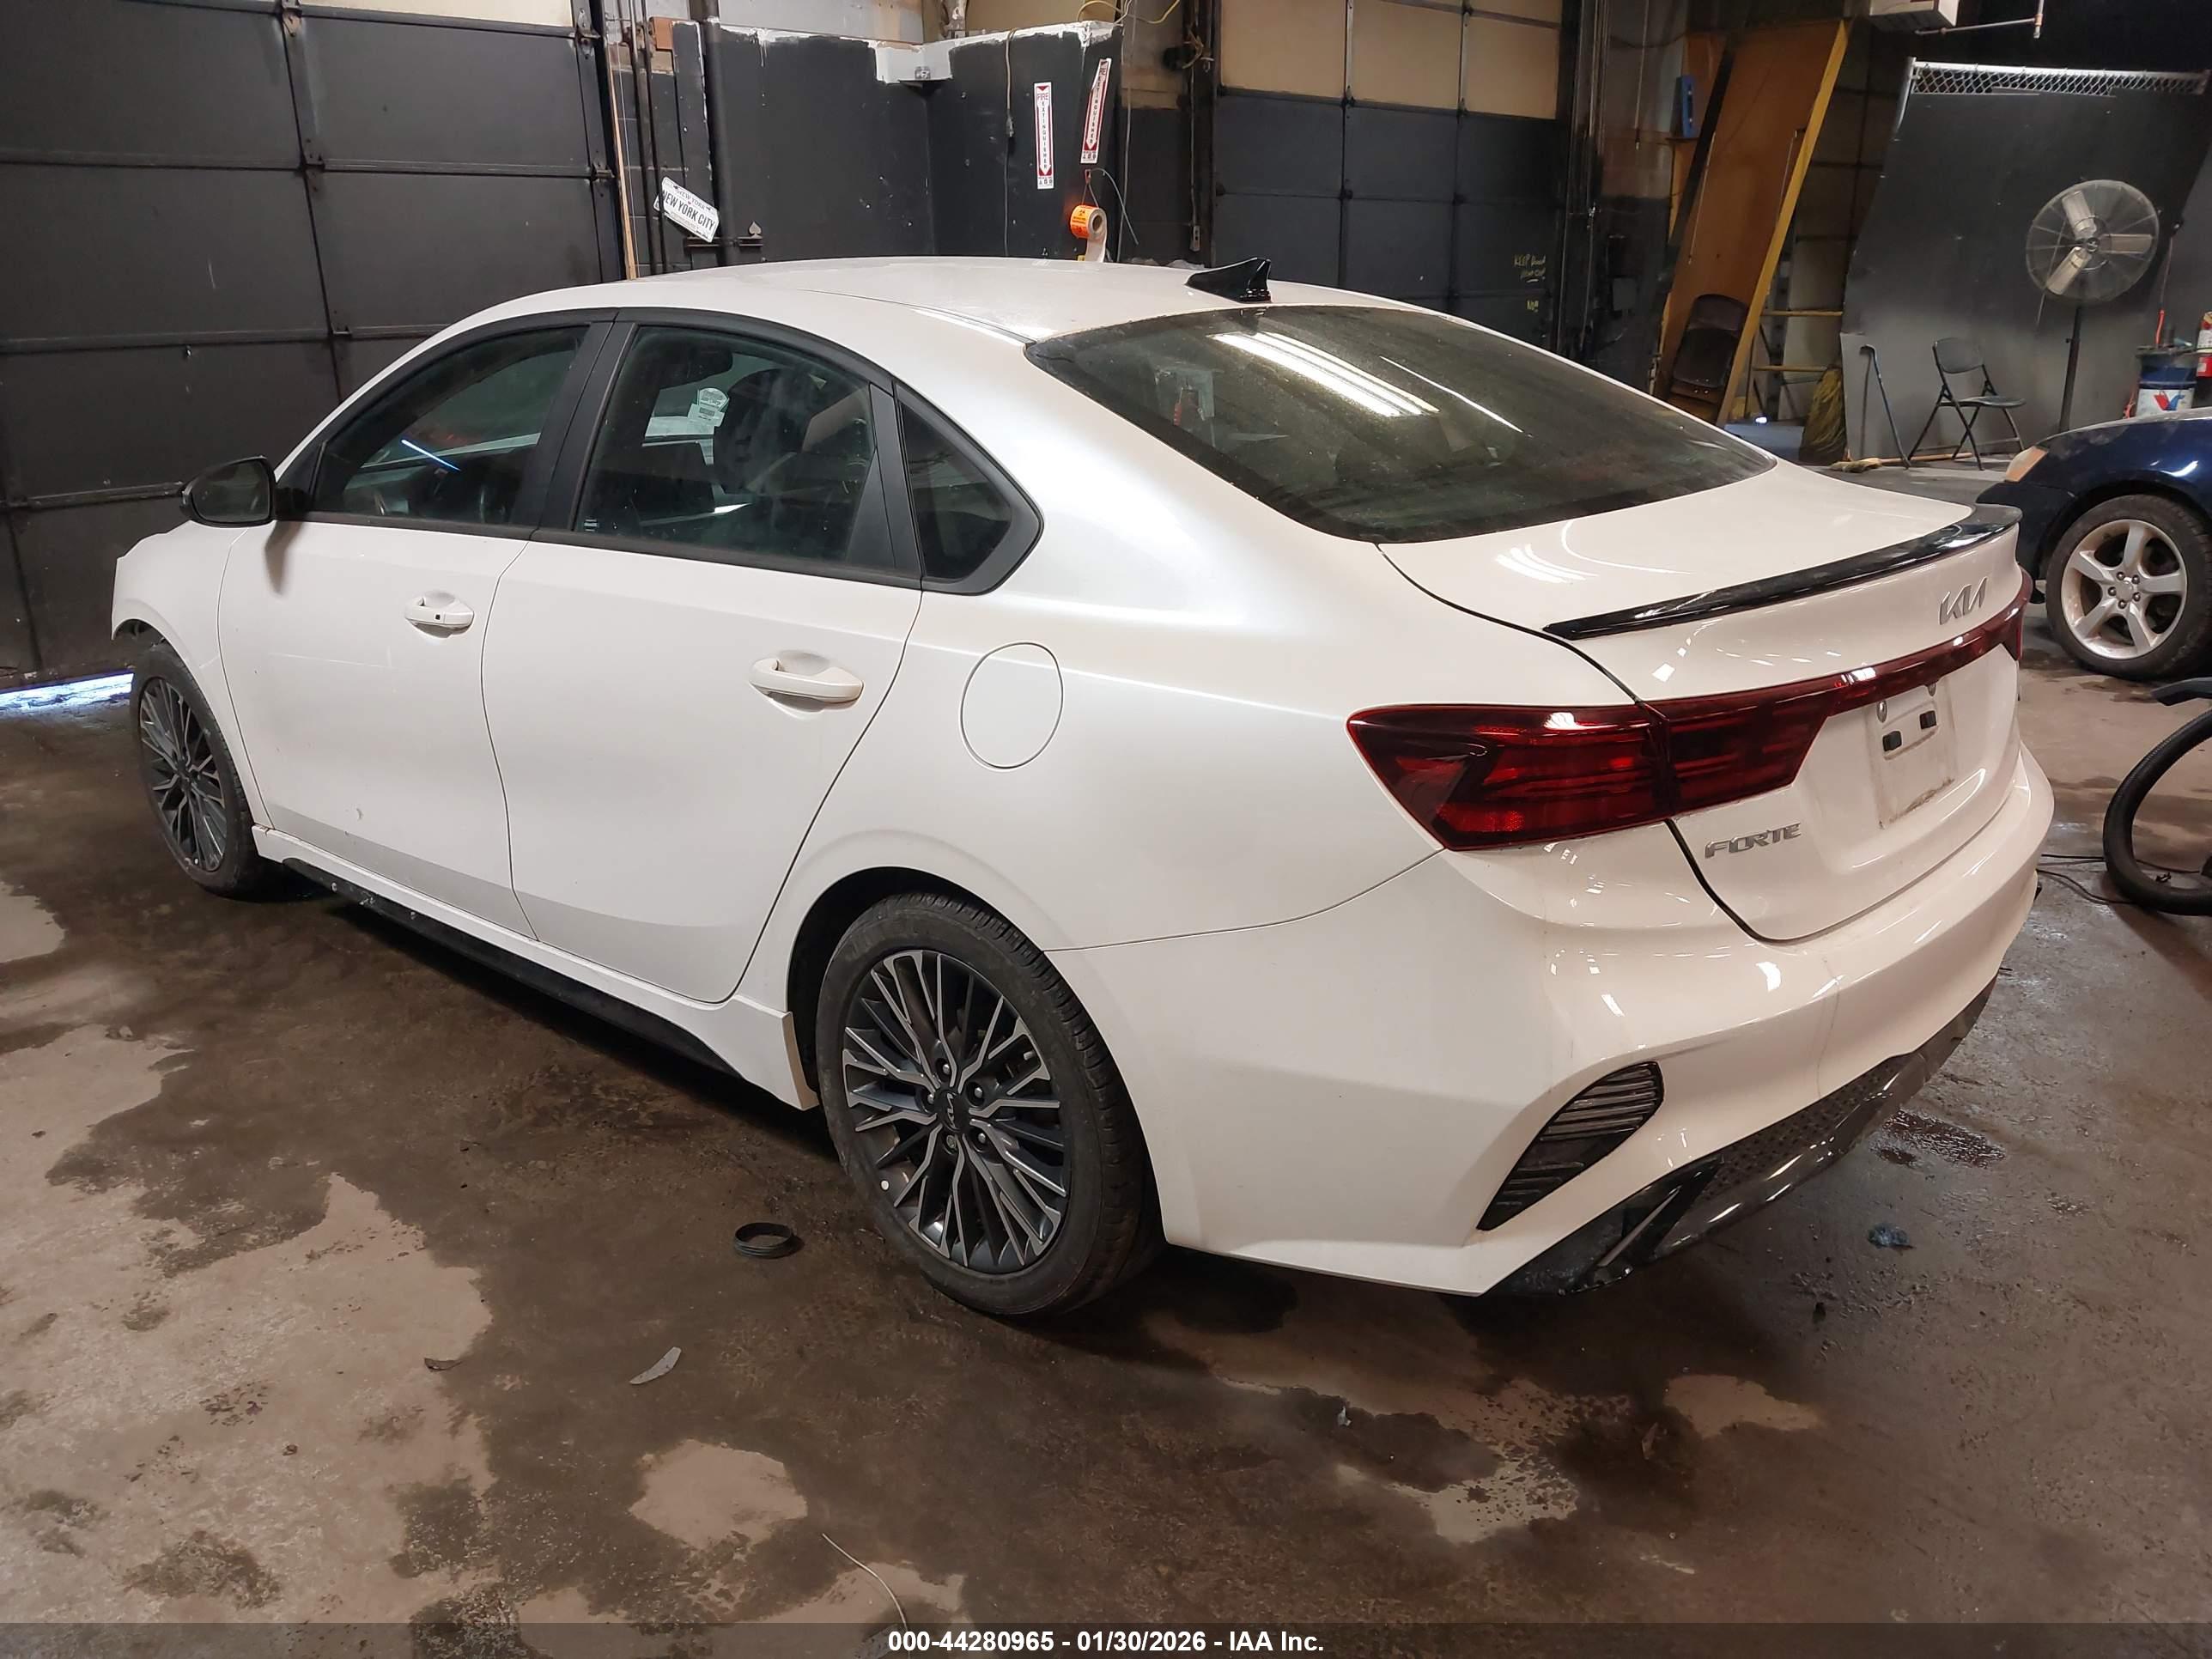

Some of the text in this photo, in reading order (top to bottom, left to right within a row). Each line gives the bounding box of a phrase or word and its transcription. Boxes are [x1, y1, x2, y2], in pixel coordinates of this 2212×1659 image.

[1089, 76, 1102, 144] EXTINGUISHER
[678, 201, 698, 222] YORK
[697, 214, 716, 231] CITY
[691, 198, 706, 210] YORK
[1705, 822, 1802, 859] FORTE
